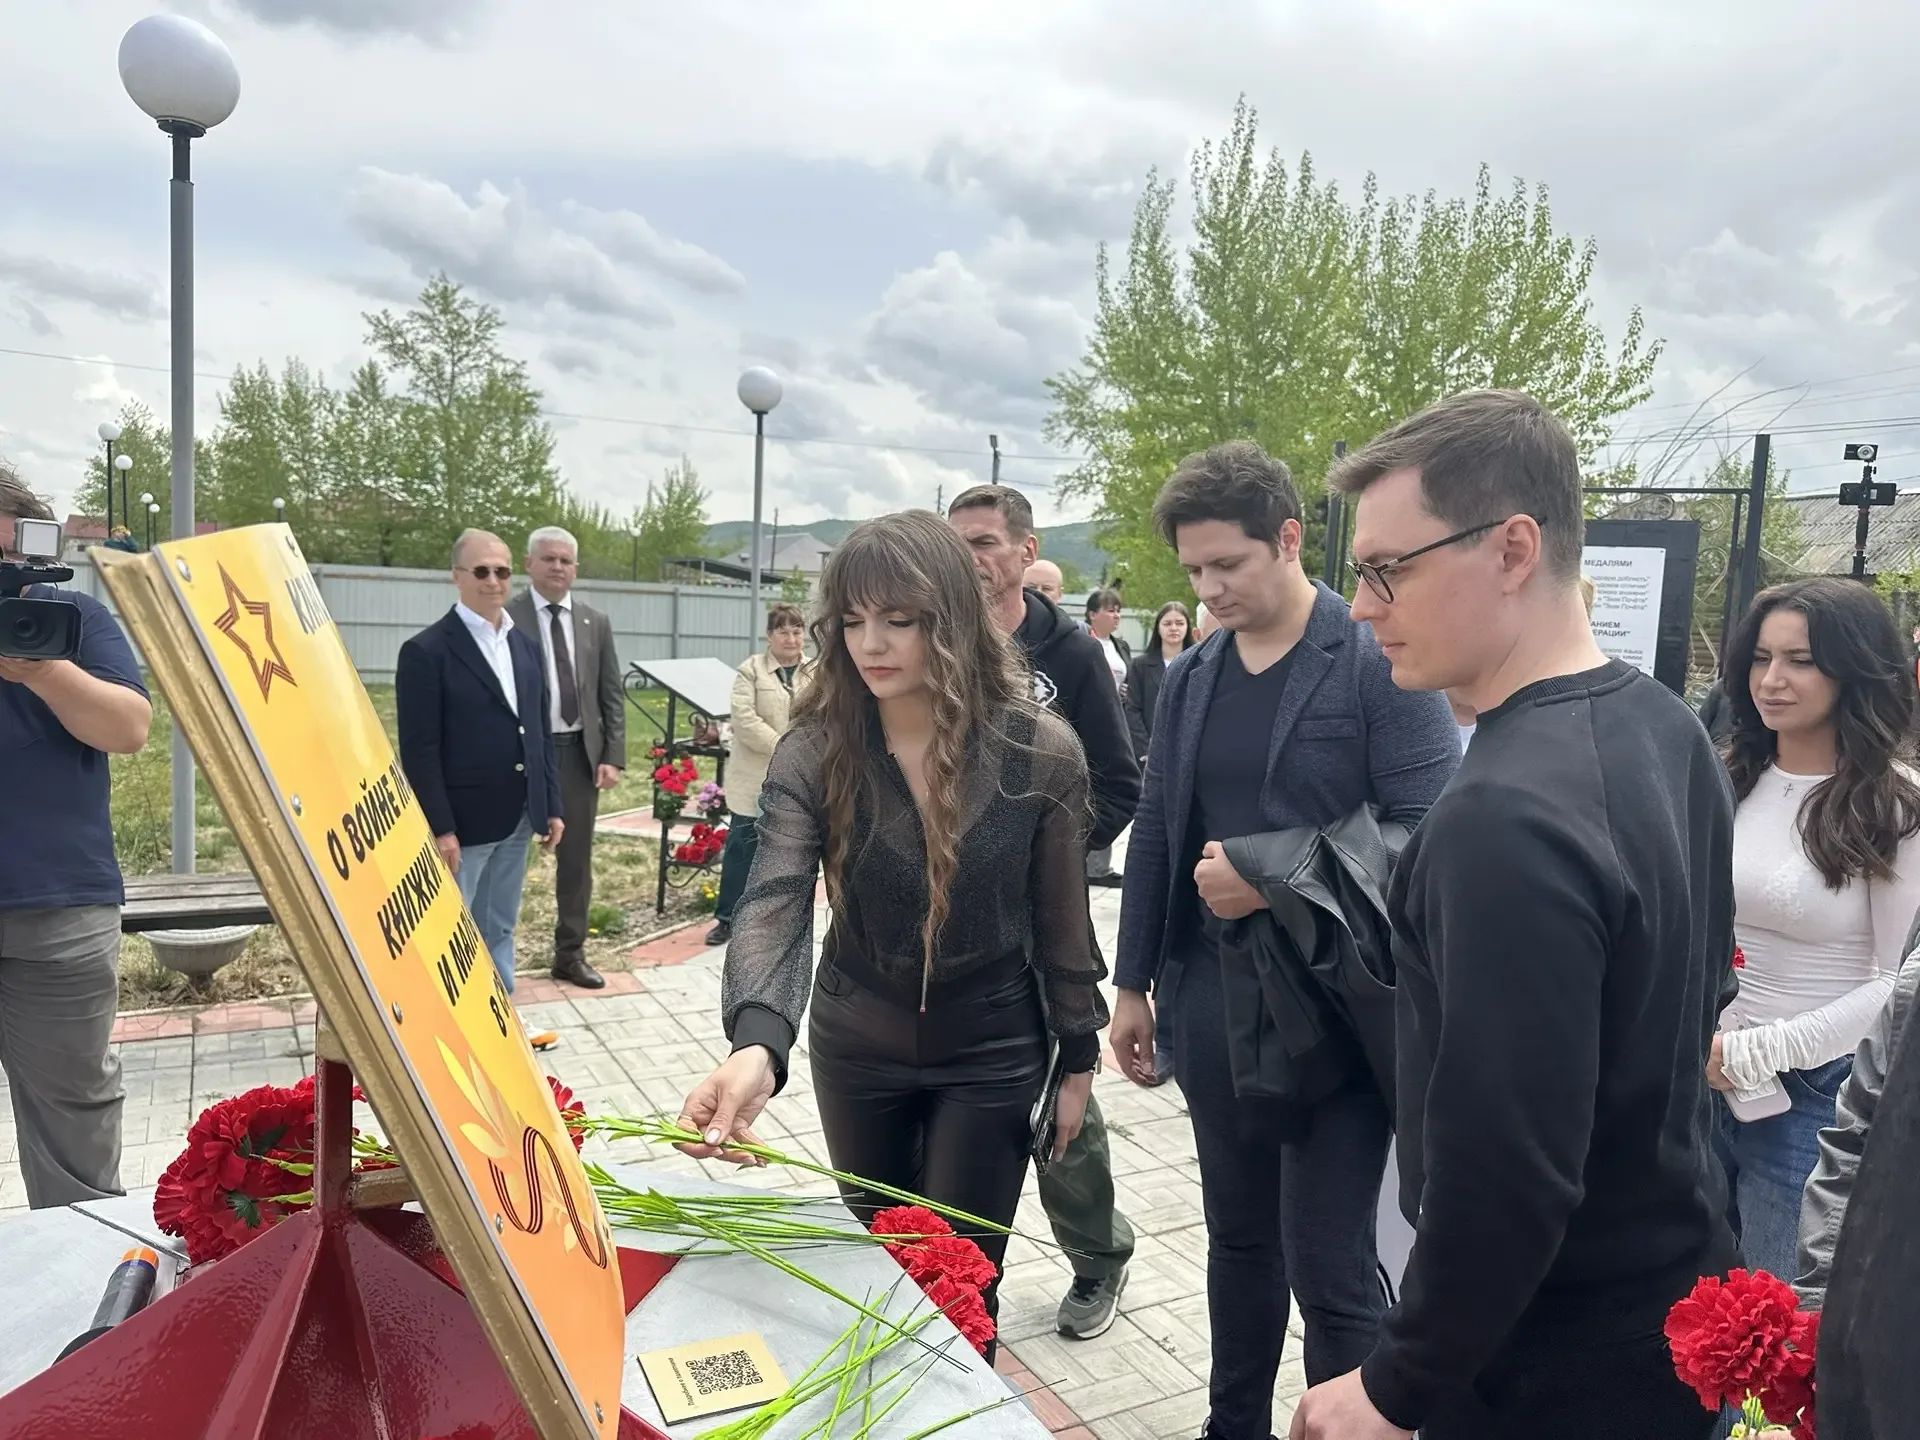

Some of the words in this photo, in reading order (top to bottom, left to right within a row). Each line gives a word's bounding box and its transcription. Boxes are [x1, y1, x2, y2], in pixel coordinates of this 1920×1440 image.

[1584, 559, 1632, 567] МЕДАЛЯМИ
[1590, 621, 1621, 629] АНИЕМ
[1592, 629, 1631, 637] ЕРАЦИИ"
[327, 828, 350, 881] О
[342, 774, 401, 864] ВОЙНЕ
[377, 842, 443, 961] КНИЖКИ
[437, 953, 460, 1007] И
